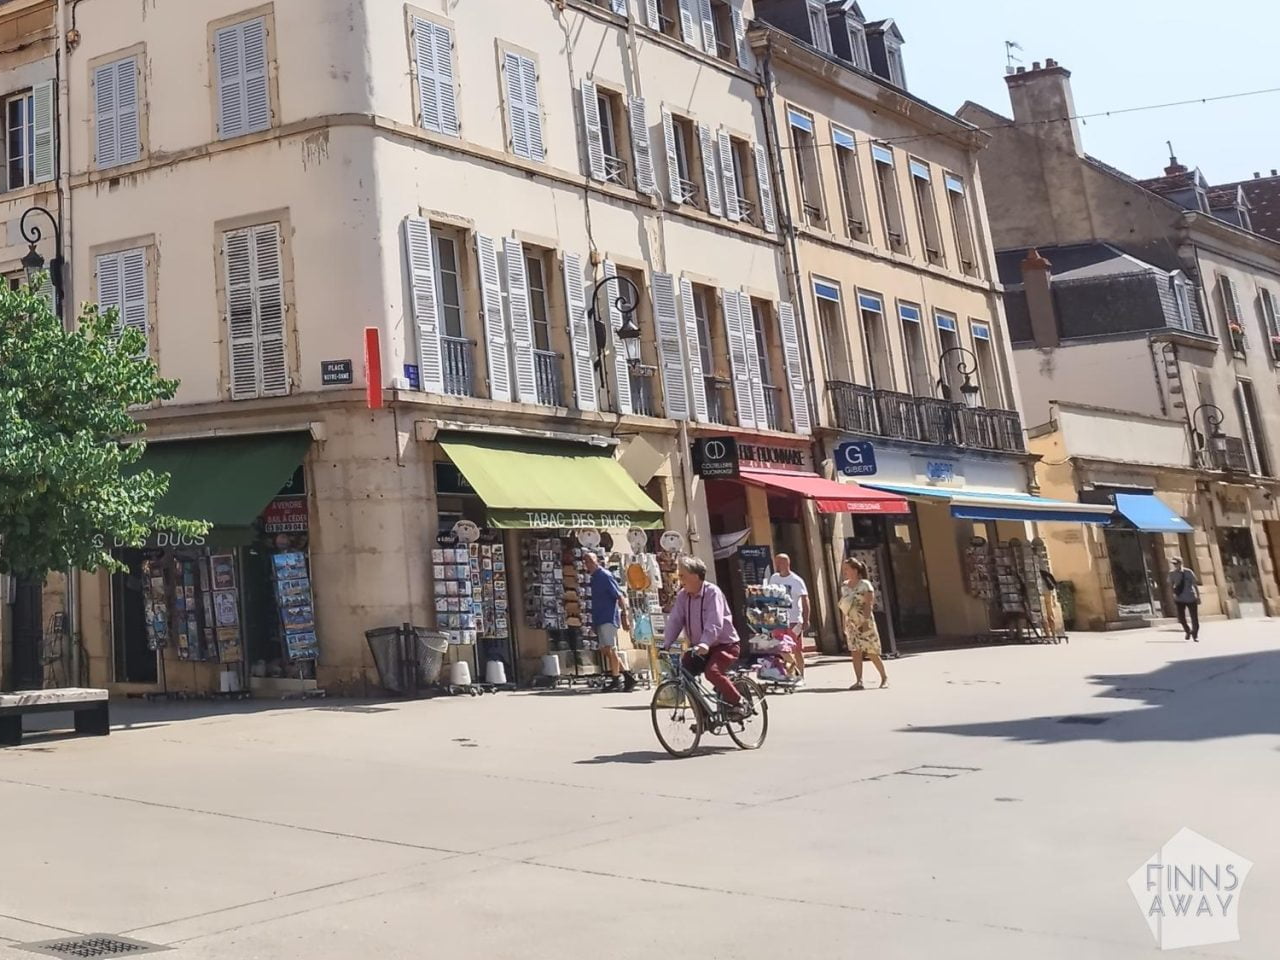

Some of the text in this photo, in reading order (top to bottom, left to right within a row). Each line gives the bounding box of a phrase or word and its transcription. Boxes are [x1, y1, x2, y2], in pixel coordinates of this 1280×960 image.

[844, 464, 874, 474] GIBERT
[526, 512, 632, 529] TABAC DES DUCS
[157, 531, 206, 547] DUCS
